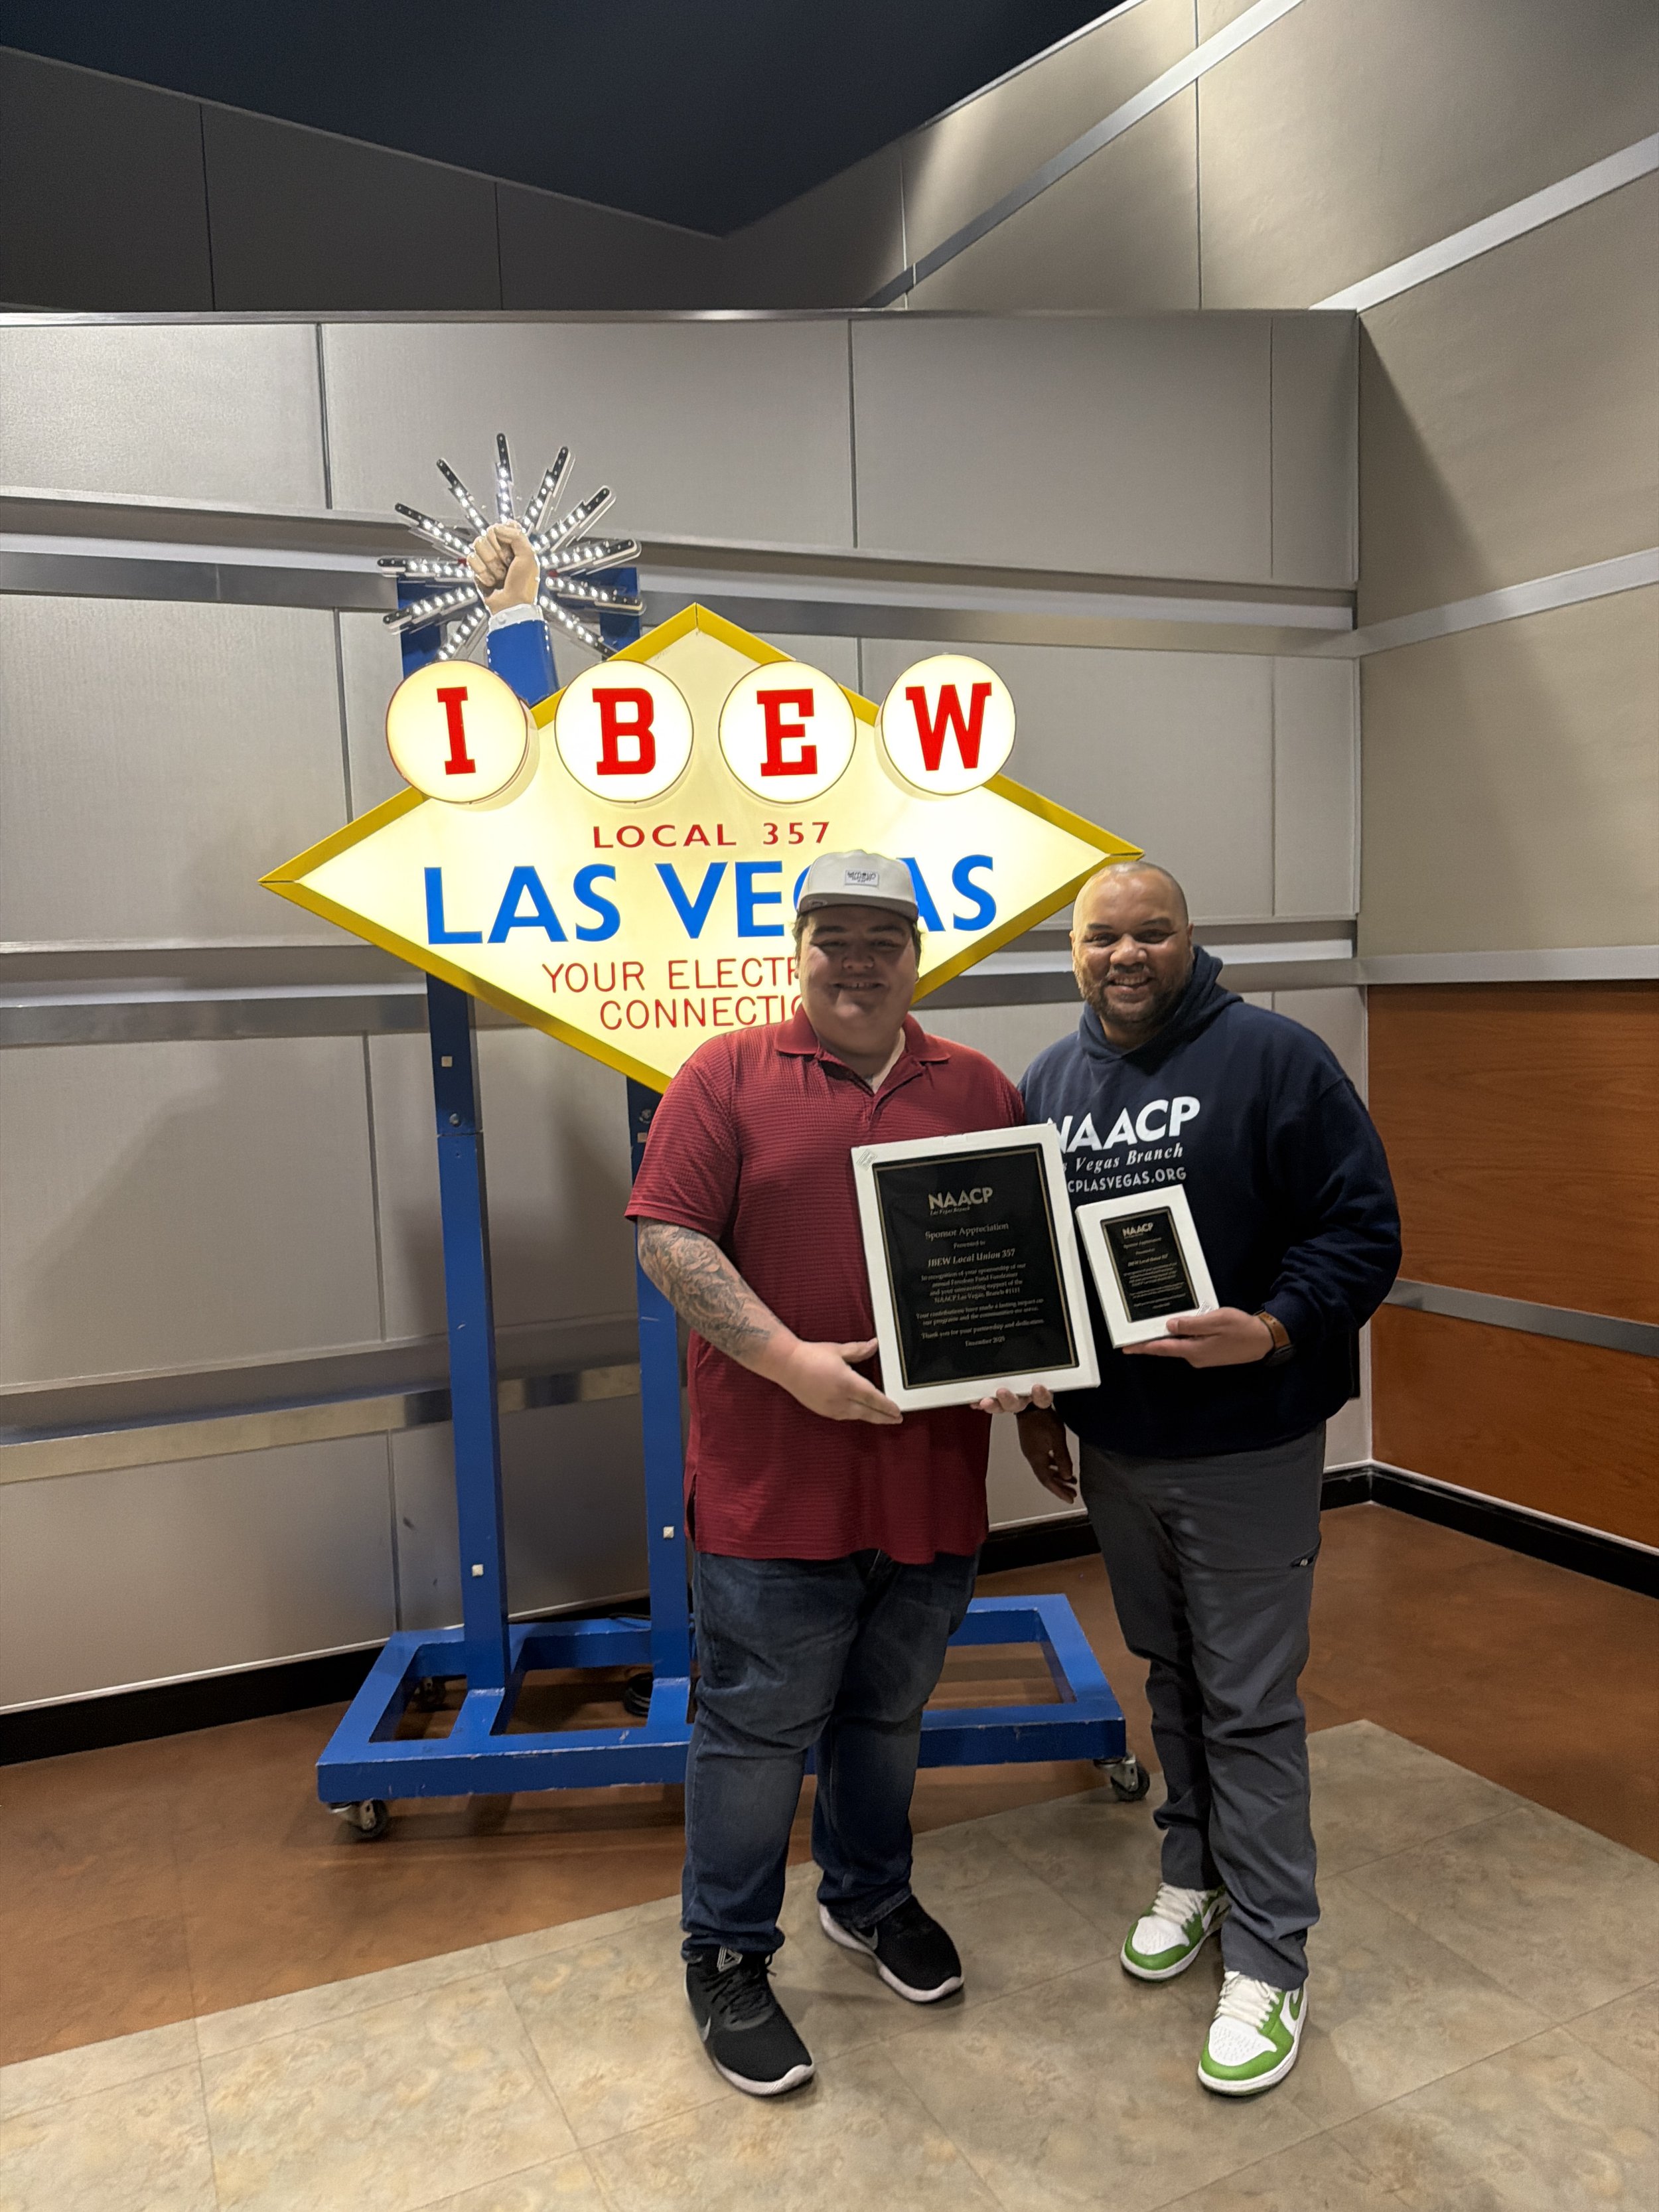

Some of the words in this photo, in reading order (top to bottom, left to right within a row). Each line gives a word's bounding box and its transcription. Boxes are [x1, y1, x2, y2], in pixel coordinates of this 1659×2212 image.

[593, 824, 736, 848] LOCAL
[763, 822, 830, 845] 357
[424, 866, 621, 945] LAS
[541, 961, 645, 994] YOUR
[1076, 1157, 1120, 1174] Vegas
[1126, 1142, 1183, 1165] Branch
[1067, 1167, 1187, 1193] CPLASVEGAS.ORG
[928, 1187, 993, 1209] NAACP
[924, 1229, 958, 1241] Sponsor
[958, 1222, 1009, 1236] Appreciation
[1122, 1222, 1154, 1237] NAACP
[928, 1256, 951, 1268] IBEW
[952, 1253, 975, 1264] Local
[976, 1251, 1001, 1261] Union
[1001, 1248, 1015, 1258] 357
